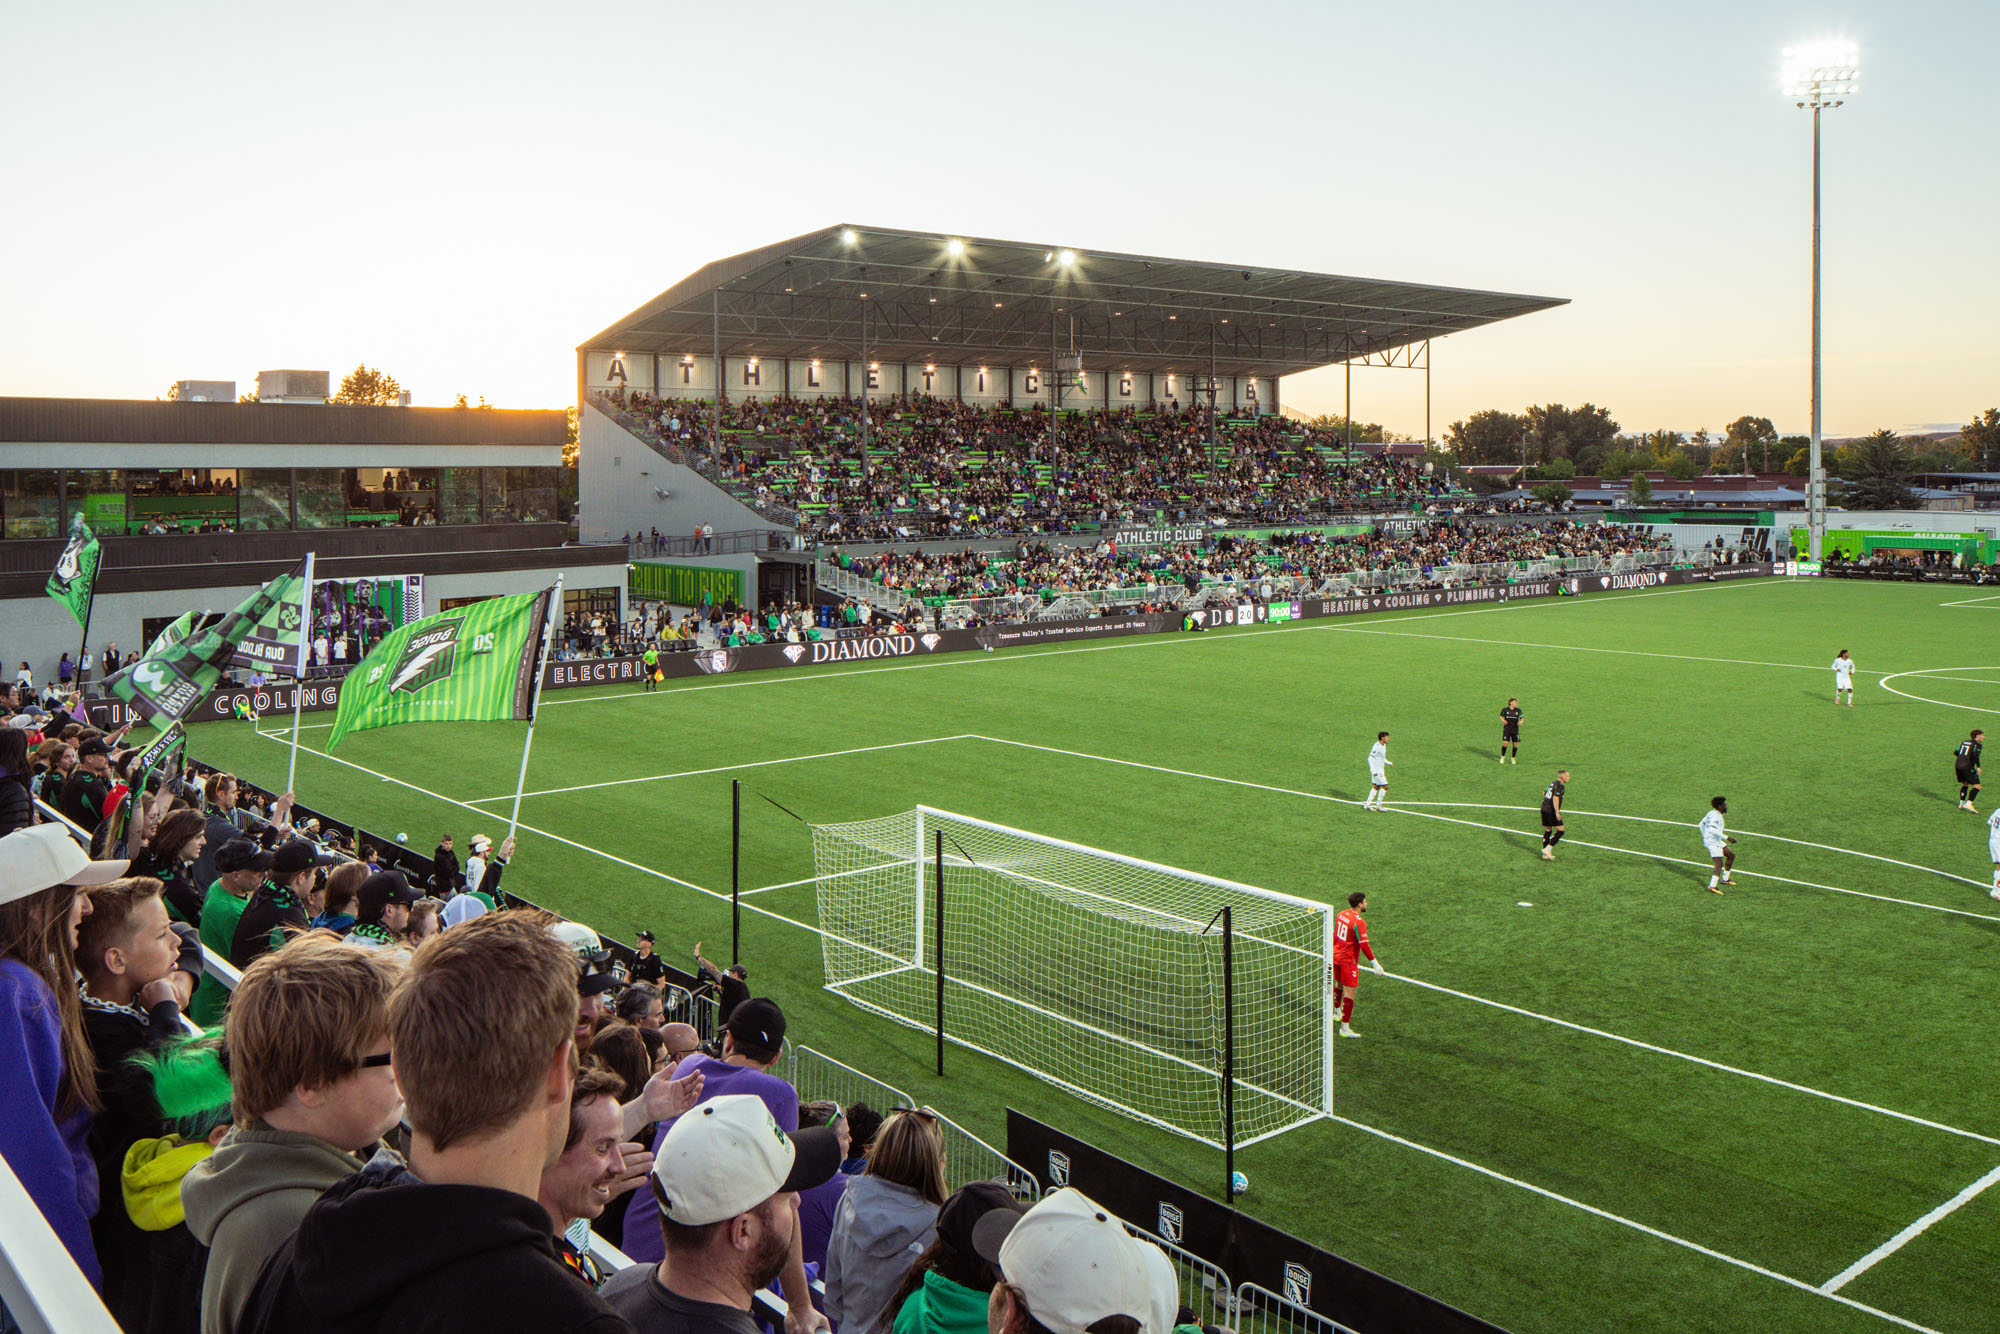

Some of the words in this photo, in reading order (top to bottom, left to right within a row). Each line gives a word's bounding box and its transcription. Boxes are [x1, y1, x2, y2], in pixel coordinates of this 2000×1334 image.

[606, 359, 1038, 395] ATHLETIC
[1115, 530, 1171, 544] ATHLETIC
[1175, 528, 1203, 541] CLUB
[1798, 563, 1820, 571] 90:00
[1612, 572, 1657, 588] DIAMOND
[1322, 599, 1369, 614] HEATING
[1385, 593, 1430, 608] COOLING
[1447, 588, 1495, 603] PLUMBING
[1509, 583, 1550, 597] ELECTRIC
[1270, 606, 1290, 618] 90:00
[998, 632, 1020, 640] Treasure
[1022, 630, 1044, 638] Valley's
[1045, 628, 1064, 636] Trusted
[1085, 625, 1103, 633] Experts
[812, 635, 916, 663] DIAMOND
[161, 680, 192, 712] GUARD
[171, 685, 198, 716] RIVER
[214, 687, 338, 714] COOLING
[1336, 921, 1349, 941] 18
[1162, 1207, 1180, 1223] BOISE
[1288, 1268, 1308, 1286] BOISE
